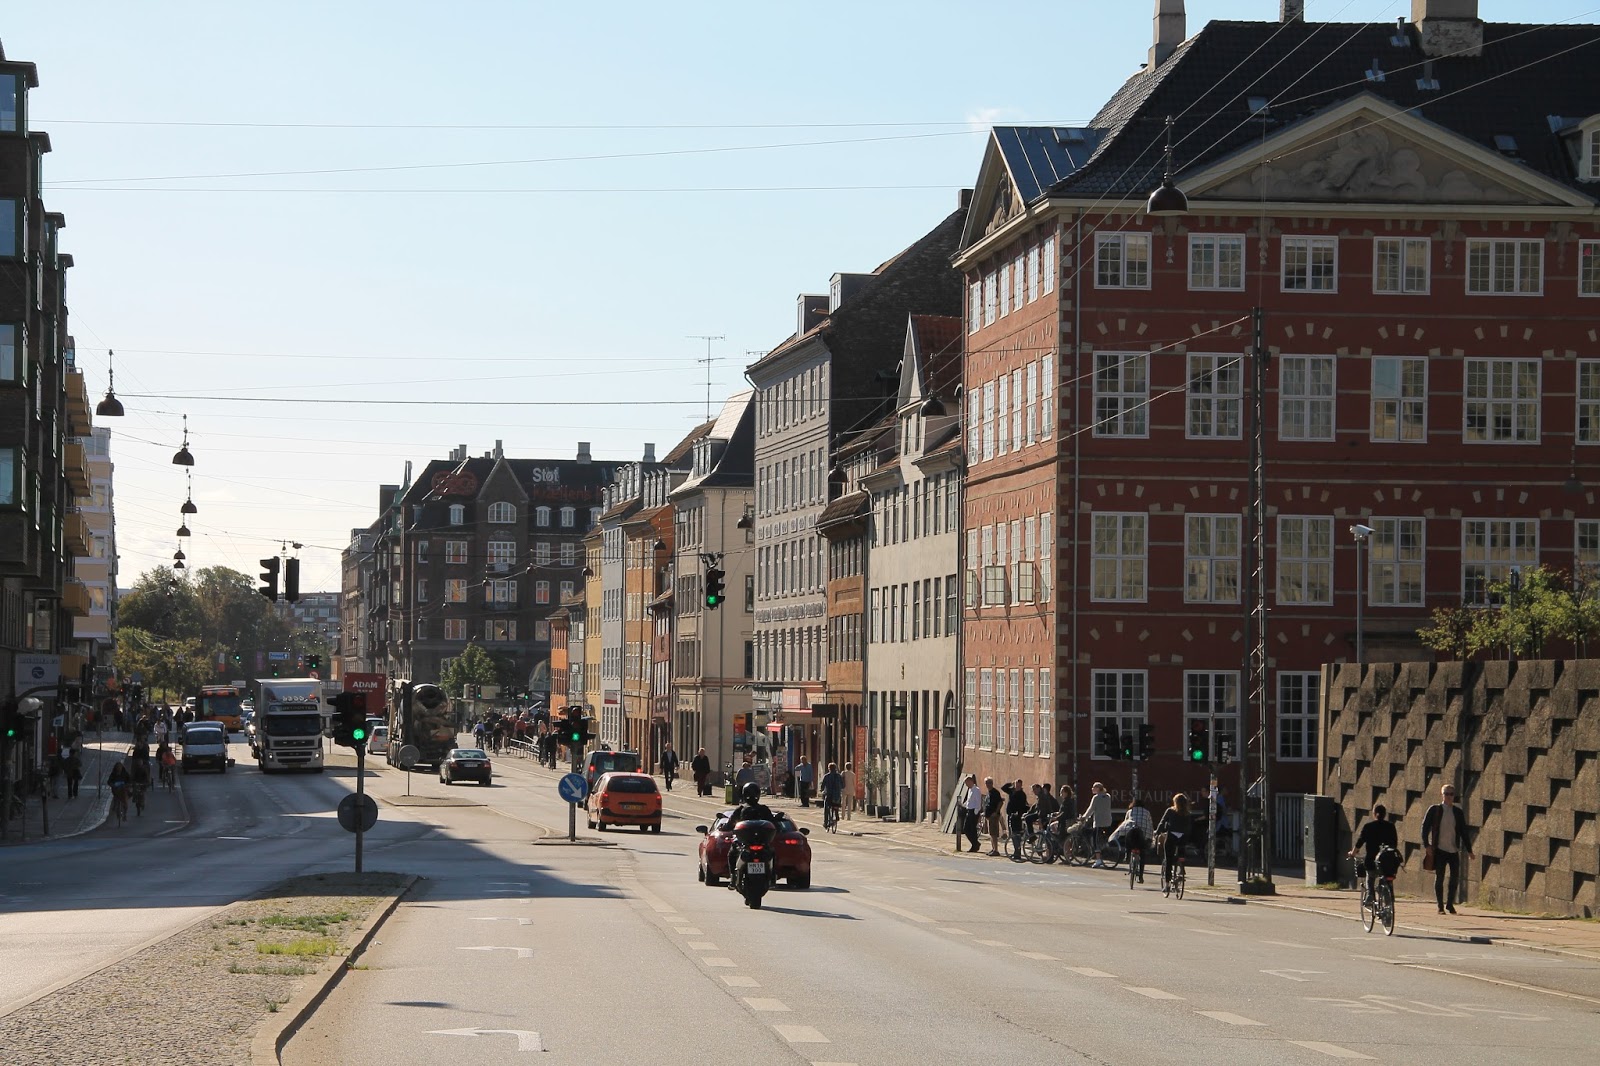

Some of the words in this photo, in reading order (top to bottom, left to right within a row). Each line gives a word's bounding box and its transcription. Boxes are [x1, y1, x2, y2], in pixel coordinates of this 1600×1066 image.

[352, 681, 378, 689] ADAM
[929, 732, 938, 763] SUSHI
[928, 768, 938, 802] SAIKO
[1111, 789, 1201, 802] RESTAURNT
